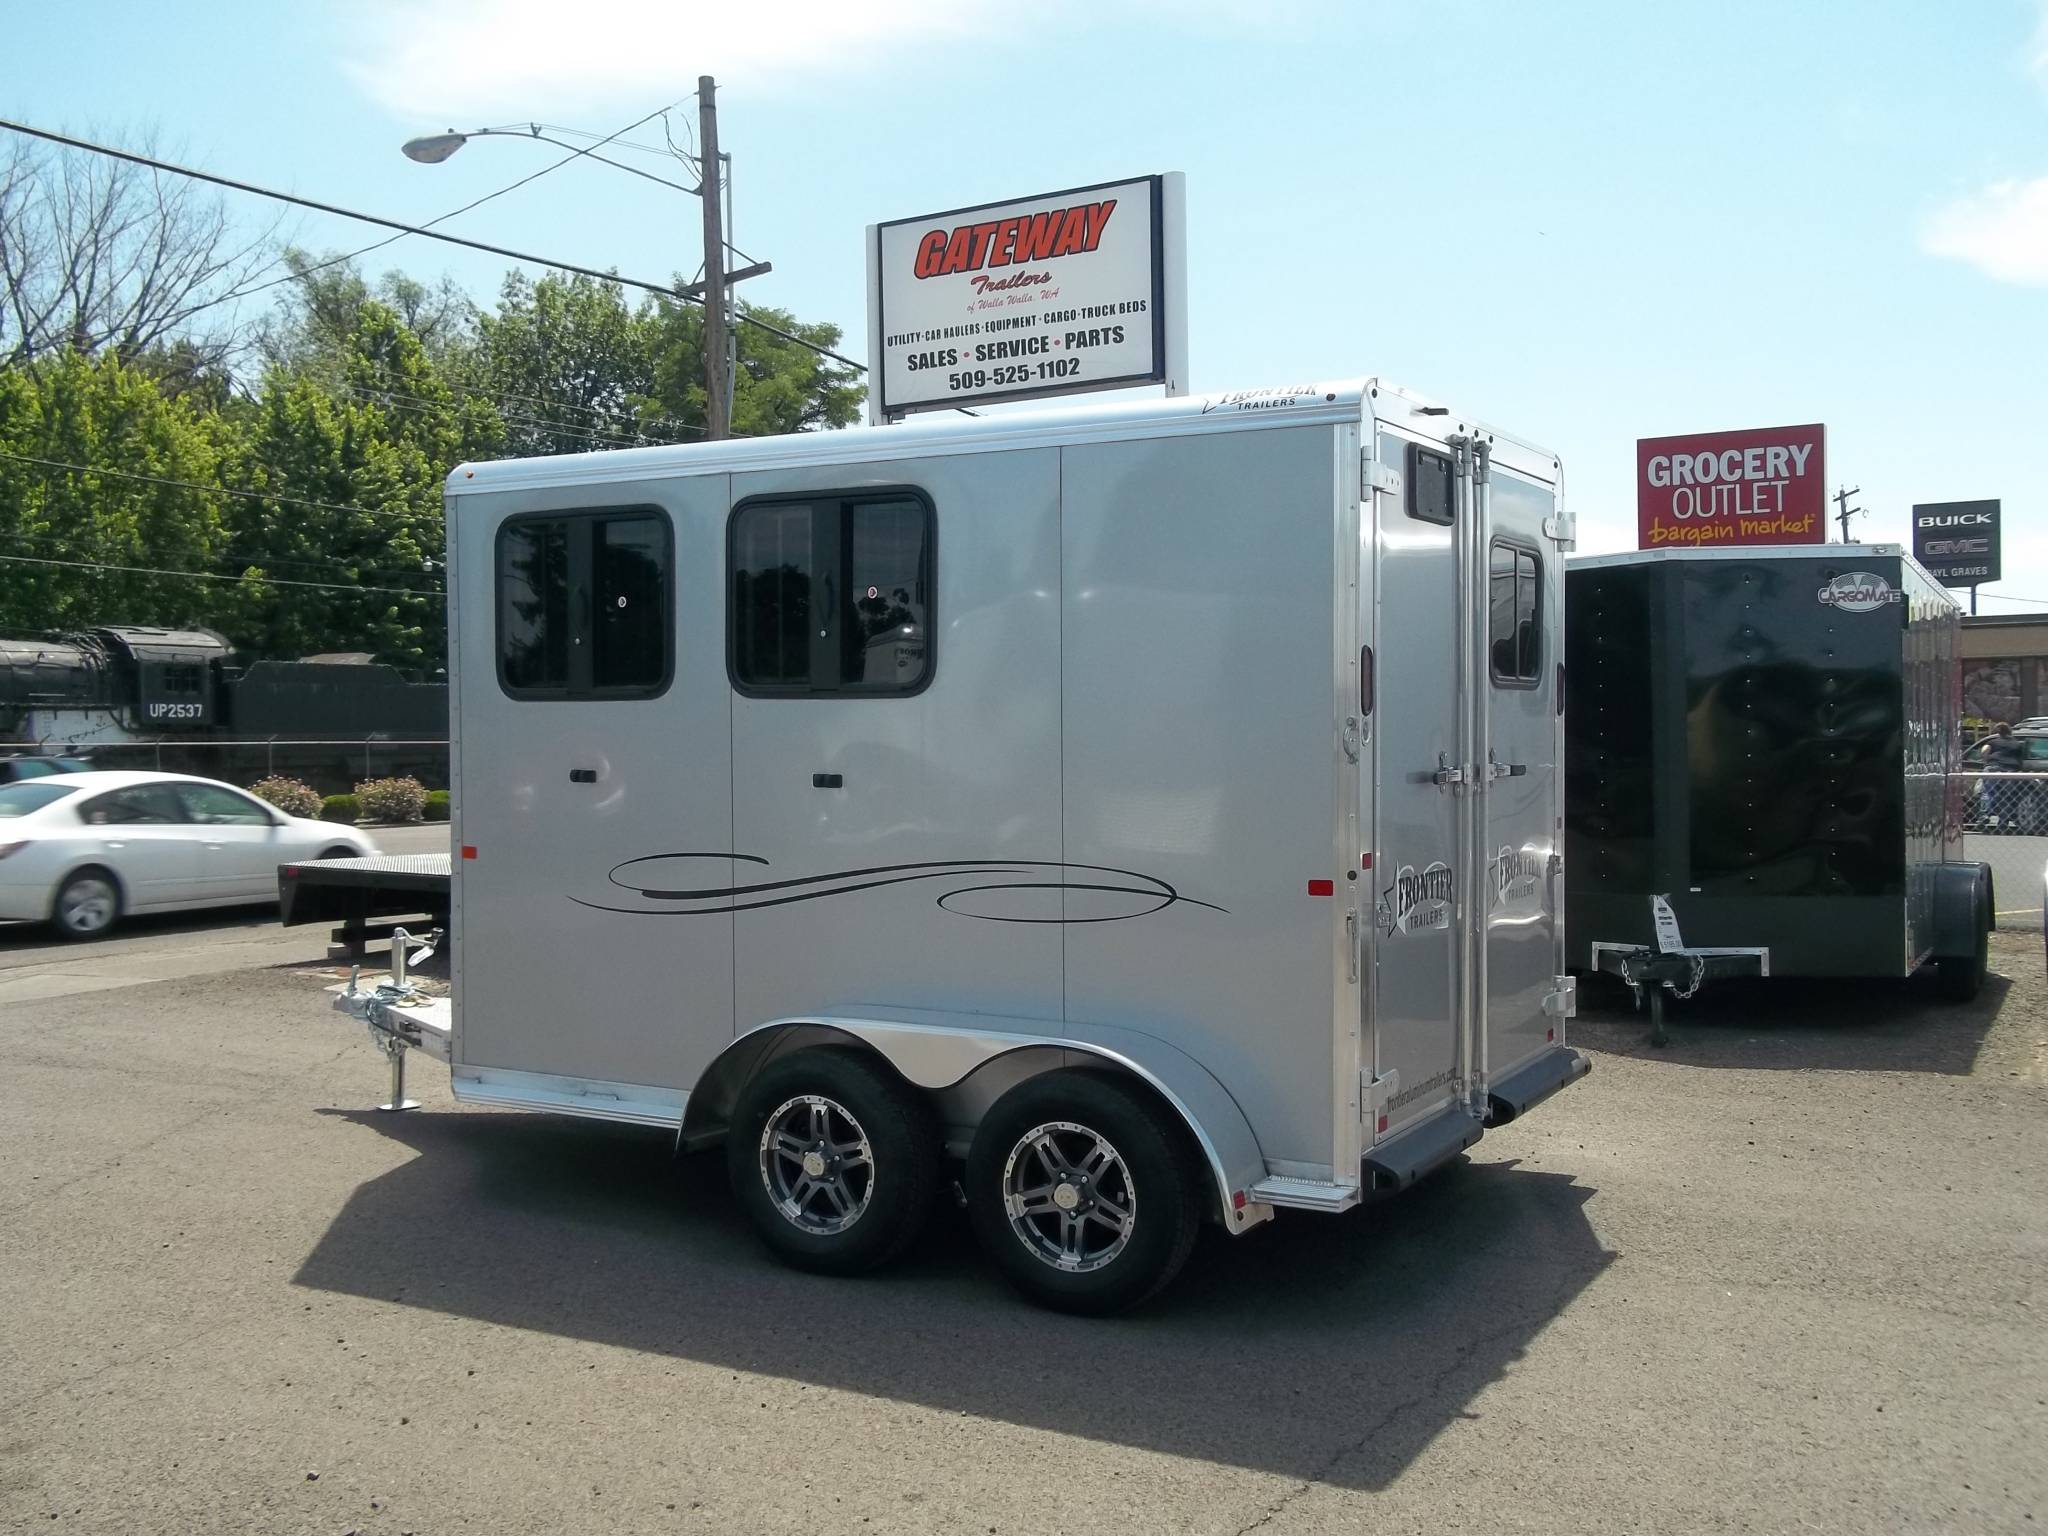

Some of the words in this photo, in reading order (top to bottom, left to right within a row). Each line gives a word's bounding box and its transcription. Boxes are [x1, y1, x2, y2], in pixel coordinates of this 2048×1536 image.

[913, 199, 1118, 280] GATEWAY
[970, 270, 1052, 295] Trailers
[966, 302, 975, 314] of
[978, 297, 1003, 310] Walla
[1040, 287, 1060, 300] WA
[887, 331, 922, 347] UTILITY
[943, 323, 981, 339] HAULERS
[985, 314, 1037, 333] EQUIPMENT
[1043, 309, 1077, 325] CARGO
[1081, 303, 1117, 320] TRUCK
[1118, 299, 1147, 315] BEDS
[907, 349, 958, 371] SALES
[975, 336, 1050, 362] SERVICE
[1065, 325, 1125, 350] PARTS
[949, 357, 1081, 391] 509-525-1102
[1237, 397, 1296, 411] TRAILERS
[1647, 443, 1813, 488] GROCERY
[1671, 480, 1790, 519] OUTLET
[1648, 516, 1735, 546] bargain
[1739, 513, 1814, 537] market
[1918, 512, 1993, 528] BUICK
[1924, 538, 1989, 555] GMC
[1951, 566, 1988, 577] GRAVES
[149, 703, 203, 718] UP2537
[1398, 867, 1453, 919] FRONTIER
[1409, 909, 1442, 930] TRAILERS
